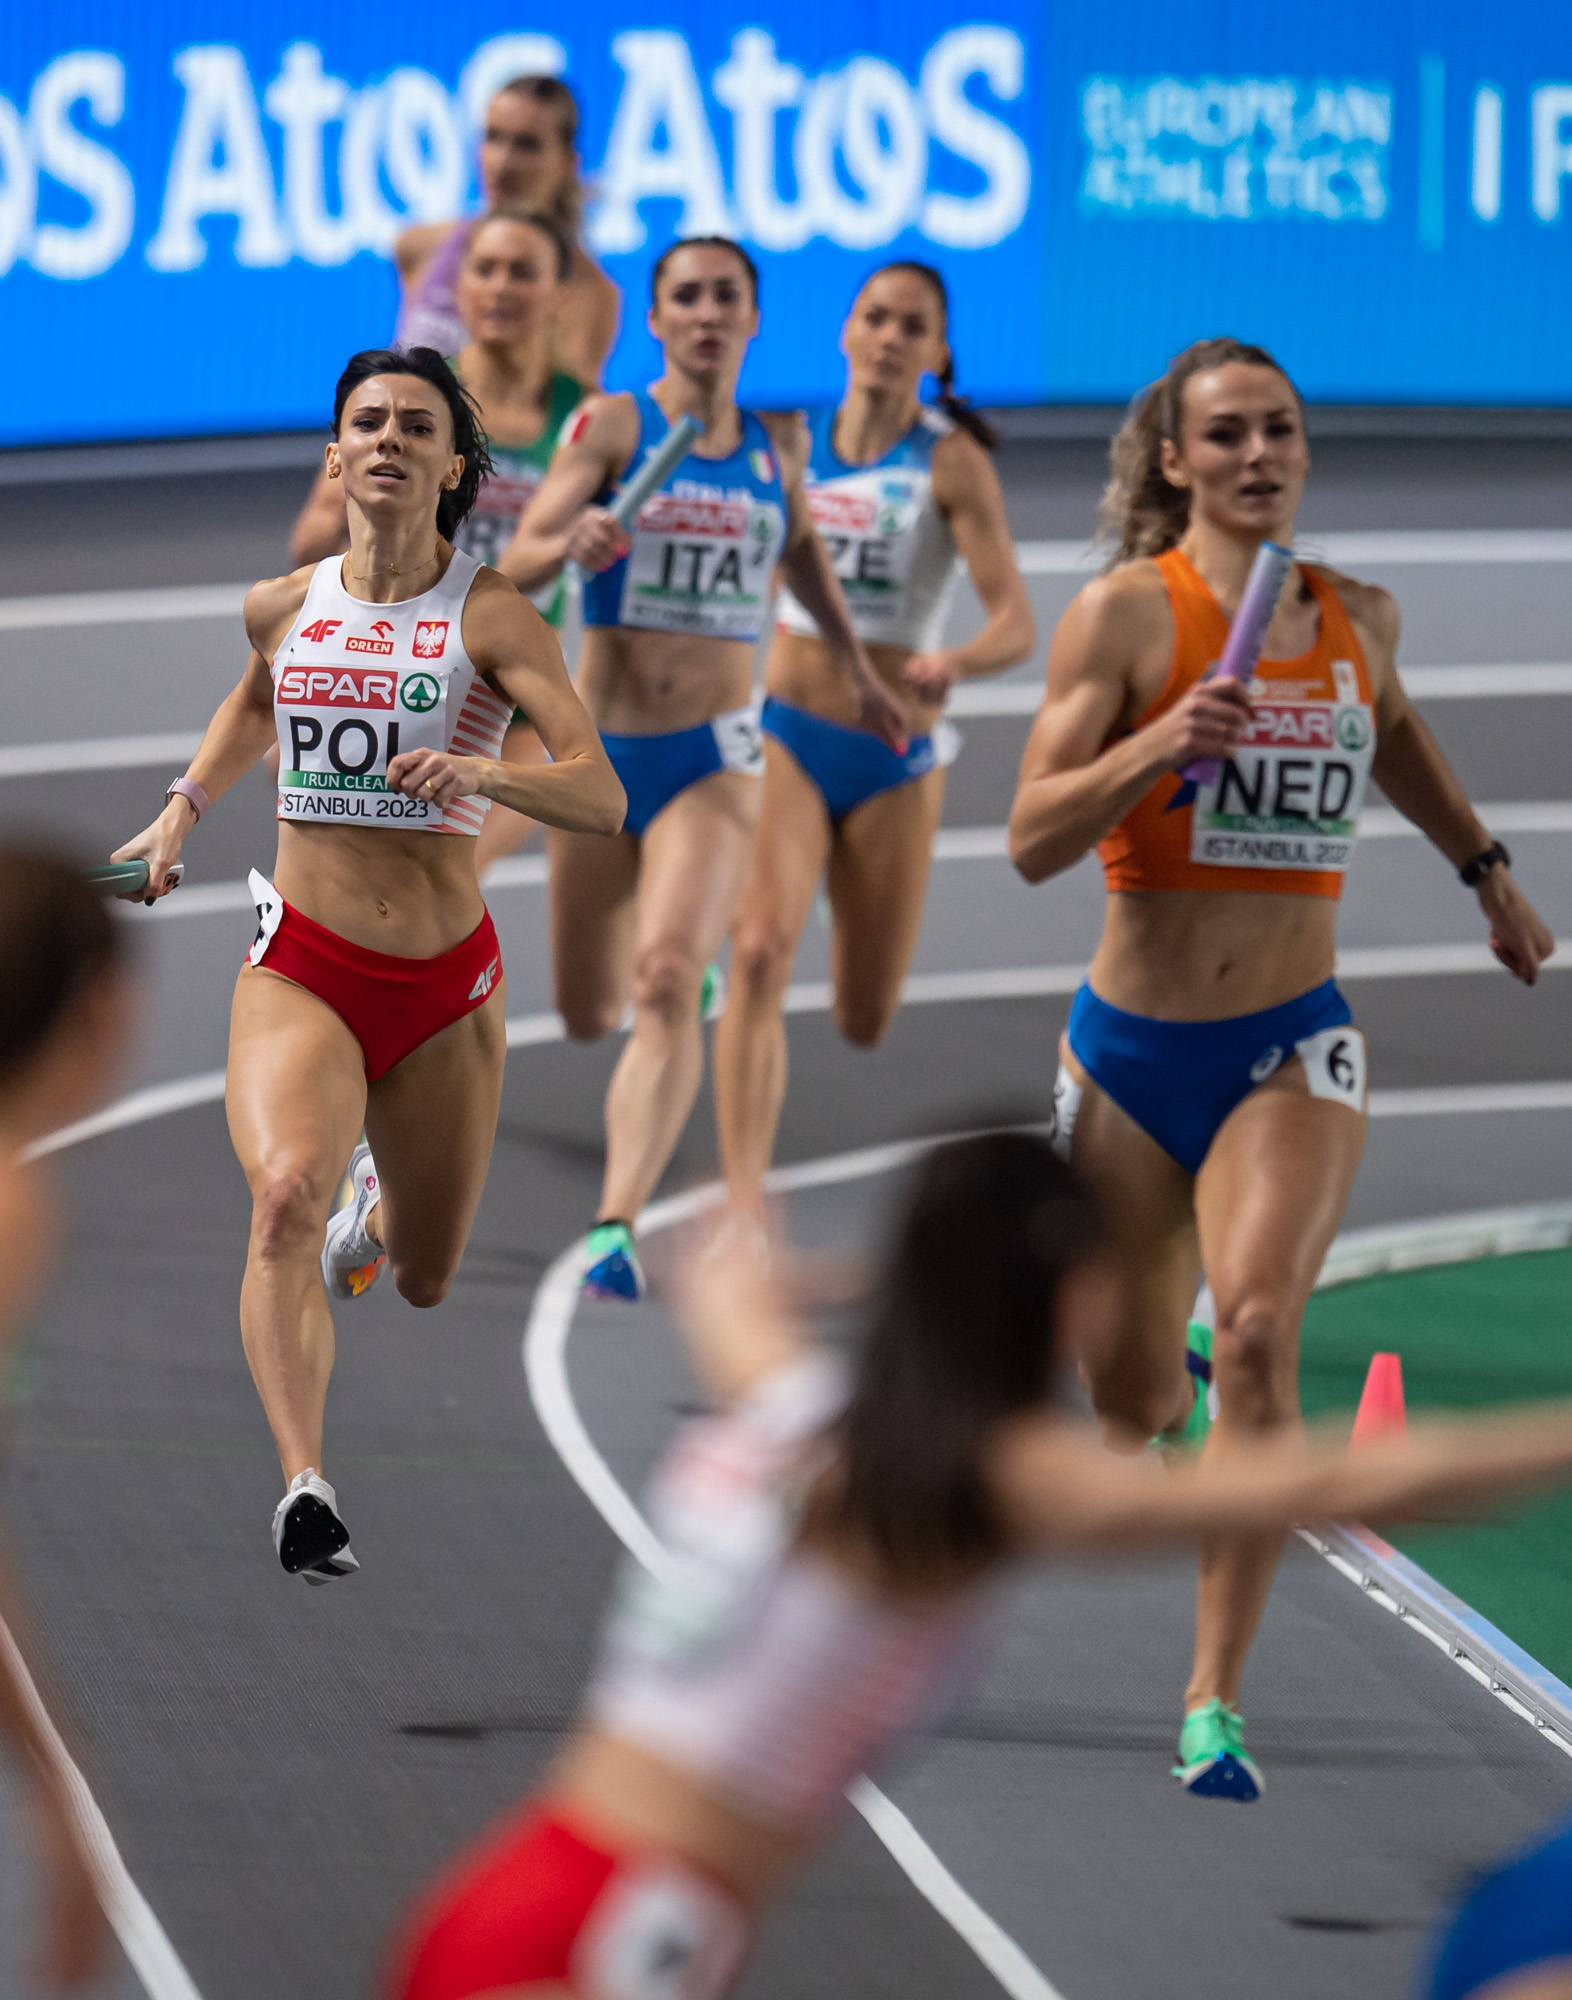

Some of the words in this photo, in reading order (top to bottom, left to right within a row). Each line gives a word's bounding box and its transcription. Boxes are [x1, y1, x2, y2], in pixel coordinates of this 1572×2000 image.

[1082, 78, 1391, 149] EUROPEAN
[1080, 143, 1390, 221] ATHLETICS
[661, 542, 744, 597] ITA
[300, 619, 343, 643] 4F
[348, 638, 392, 654] ORLEN
[280, 671, 394, 705] SPAR
[1240, 710, 1333, 745] PAR
[309, 775, 340, 788] RUN
[1216, 758, 1354, 819] NED
[375, 799, 429, 818] 2023
[1327, 1039, 1354, 1092] 6
